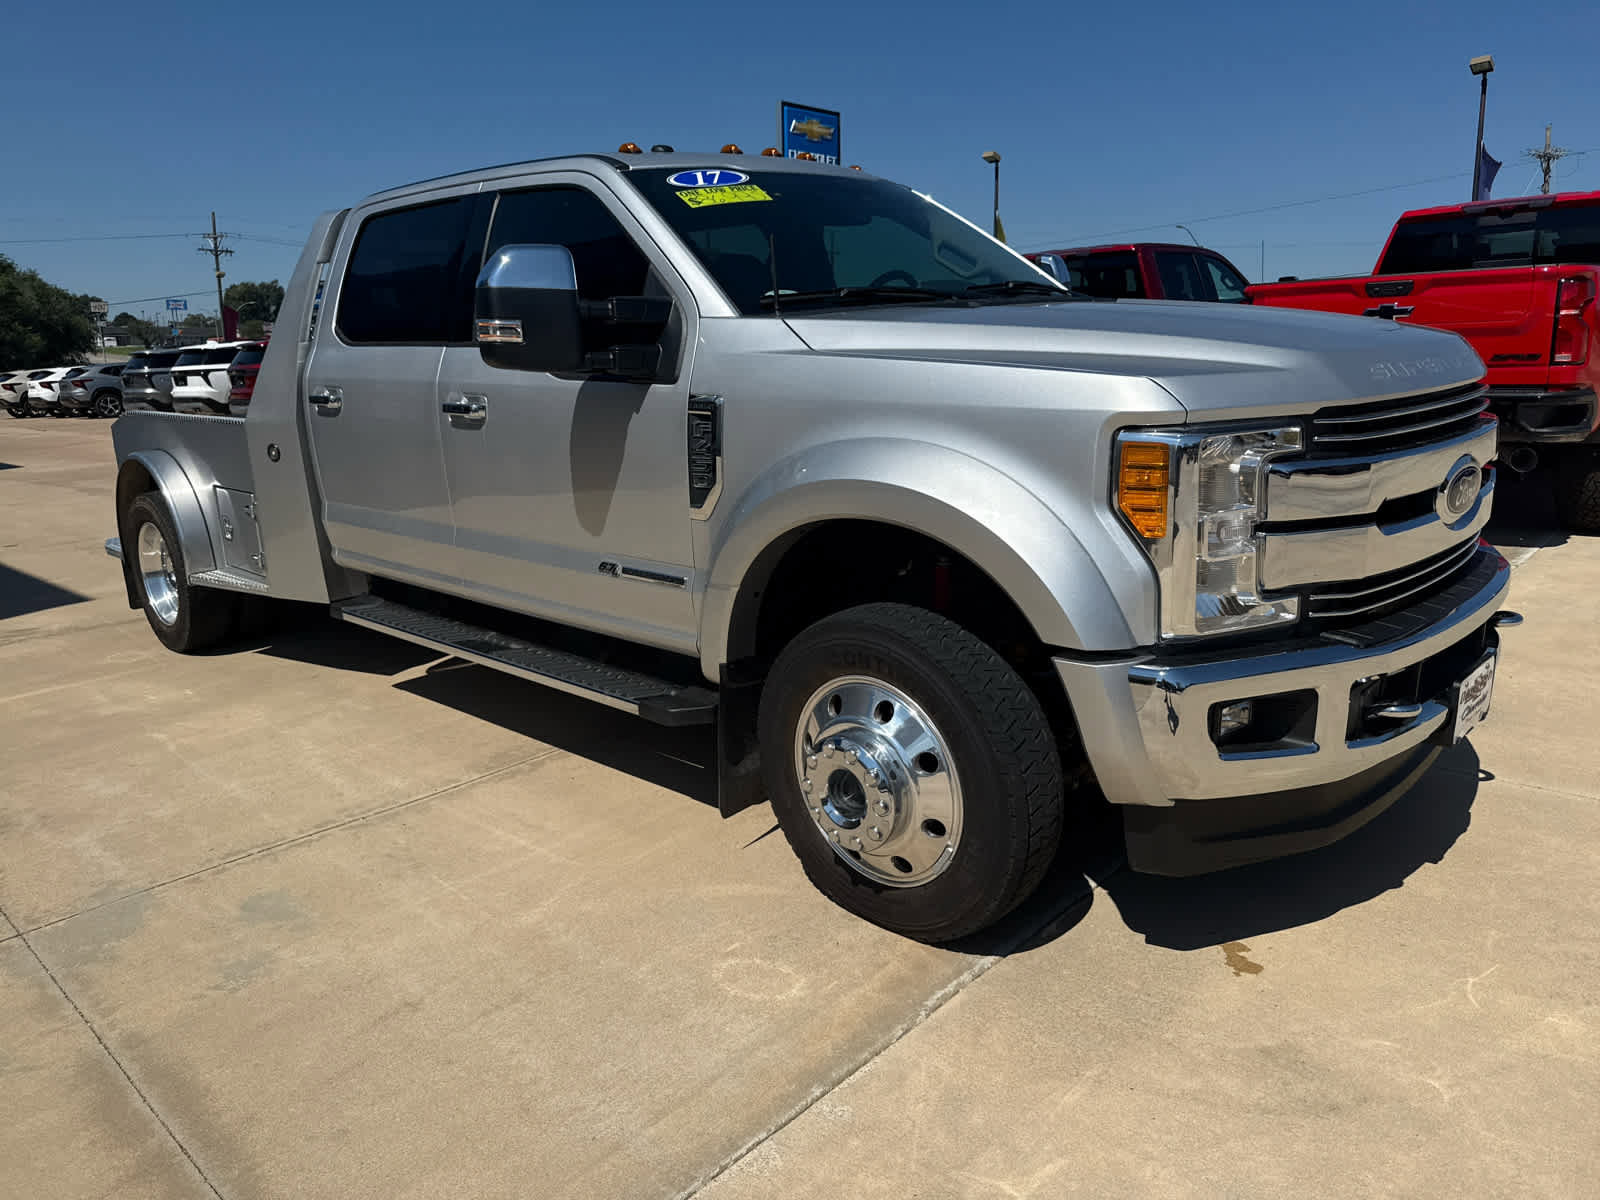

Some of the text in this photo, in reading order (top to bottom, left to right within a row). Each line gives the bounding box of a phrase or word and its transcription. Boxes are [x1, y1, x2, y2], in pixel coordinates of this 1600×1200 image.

[694, 170, 721, 186] 17
[680, 188, 702, 198] ONE
[703, 186, 728, 195] LOW
